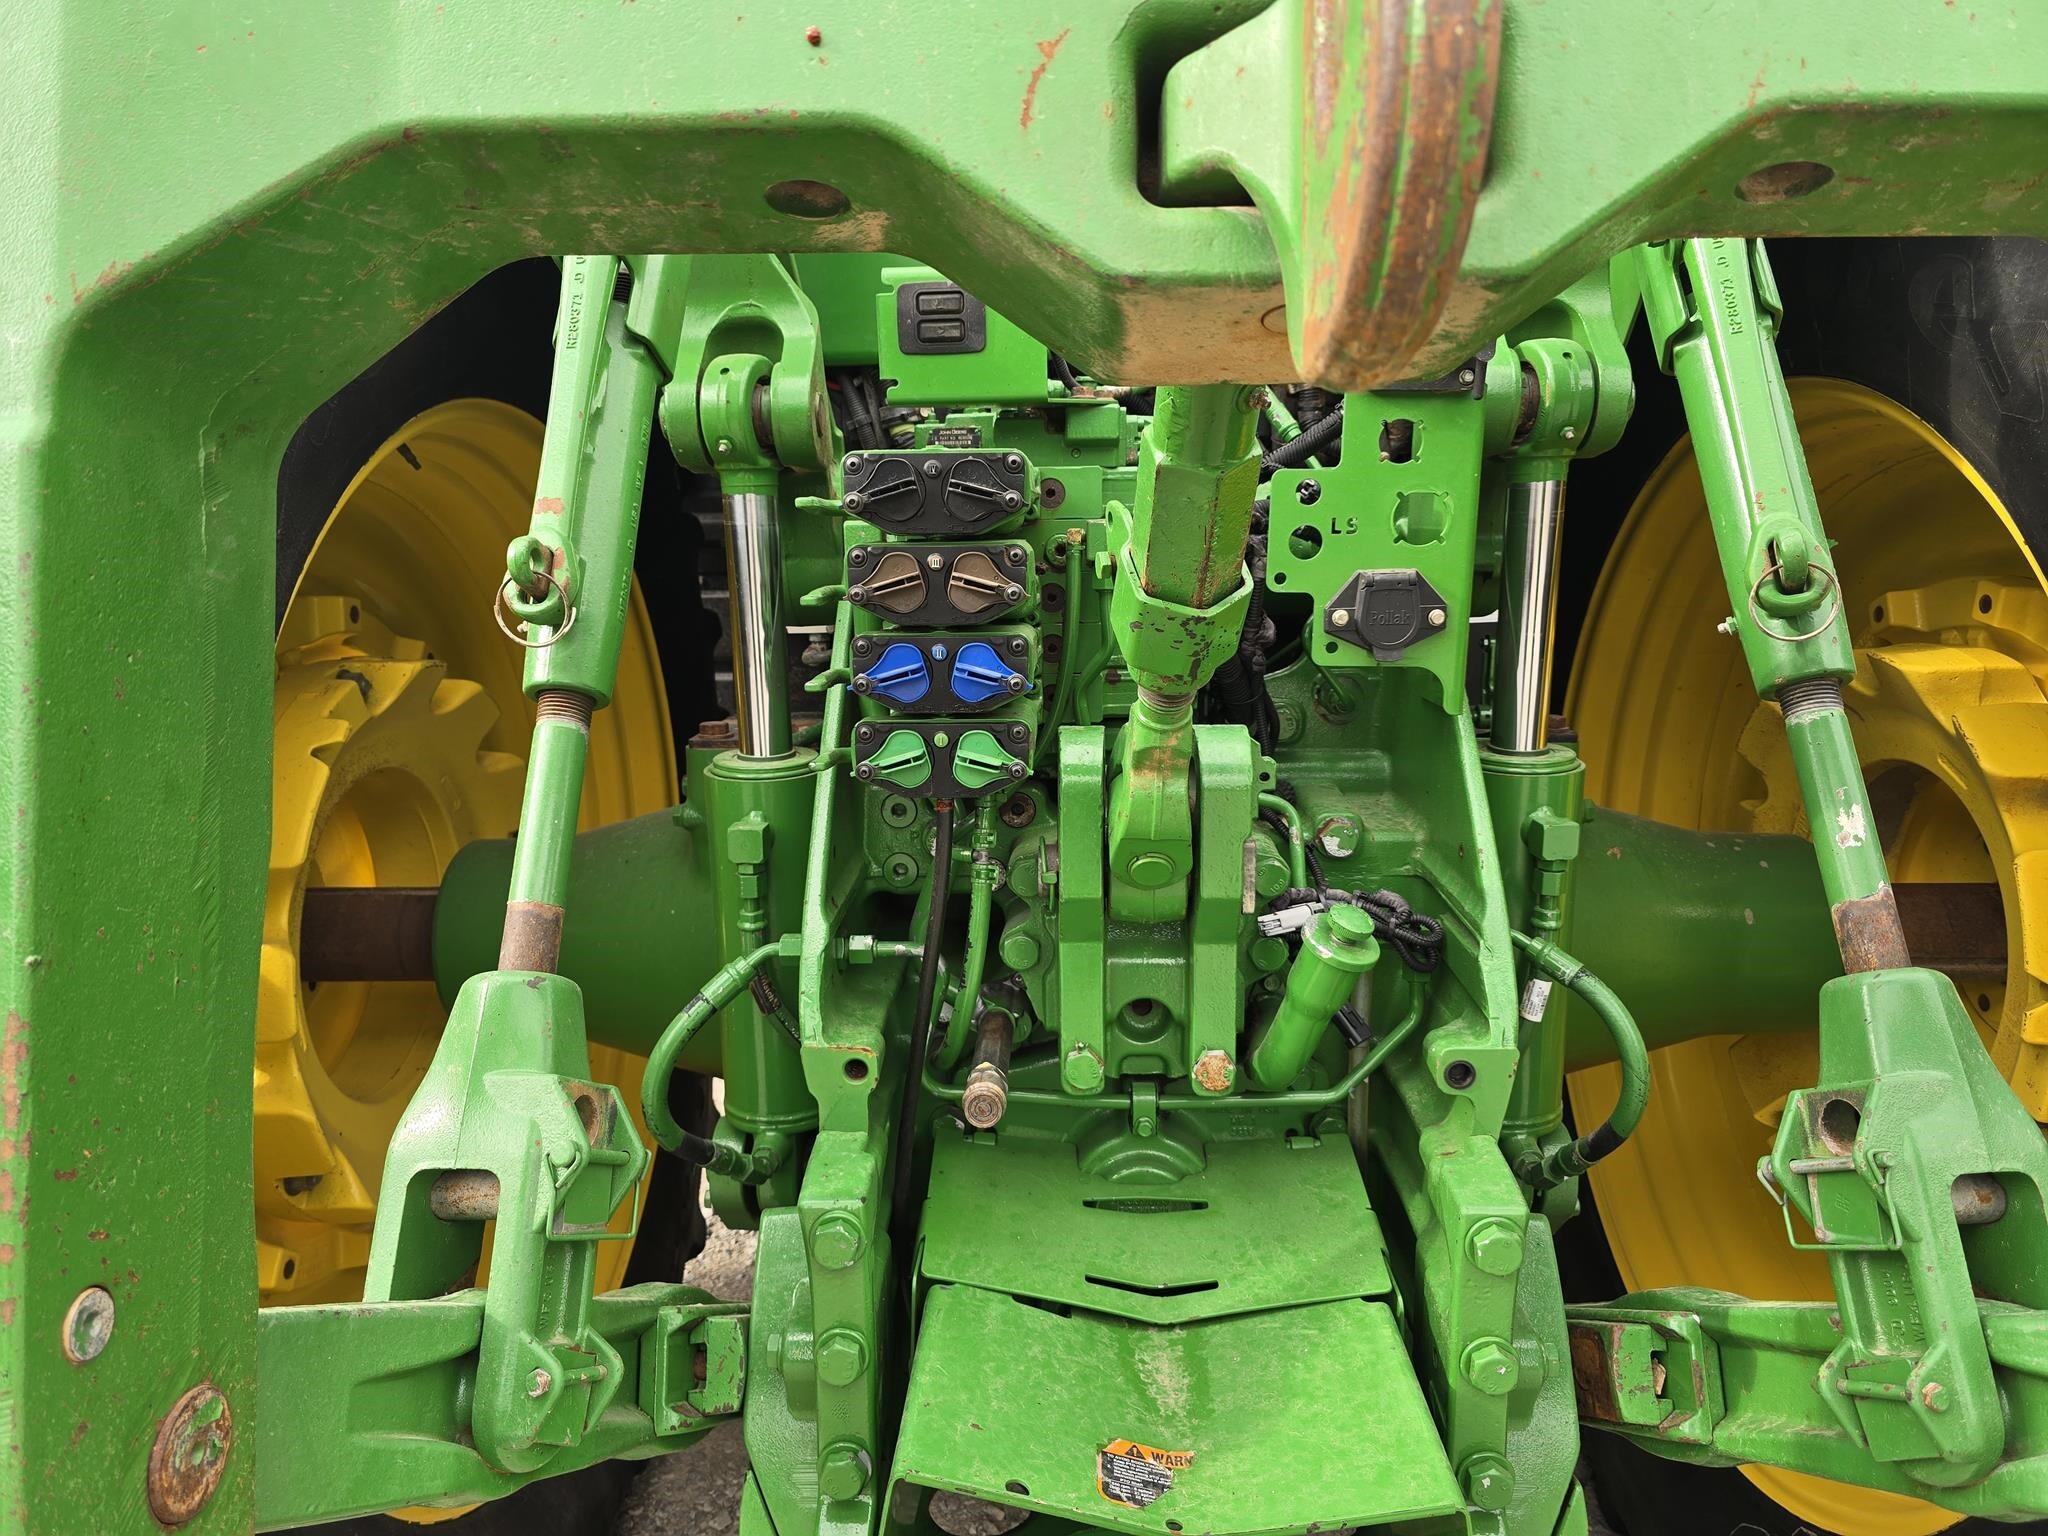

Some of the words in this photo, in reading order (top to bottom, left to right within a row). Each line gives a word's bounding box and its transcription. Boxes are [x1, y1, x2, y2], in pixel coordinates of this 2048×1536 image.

[1720, 278, 1743, 335] R280371
[565, 293, 584, 349] R280371
[928, 464, 936, 473] IV
[1330, 517, 1359, 535] LS
[930, 557, 940, 567] III
[1368, 609, 1411, 626] Pollak
[935, 648, 943, 659] II
